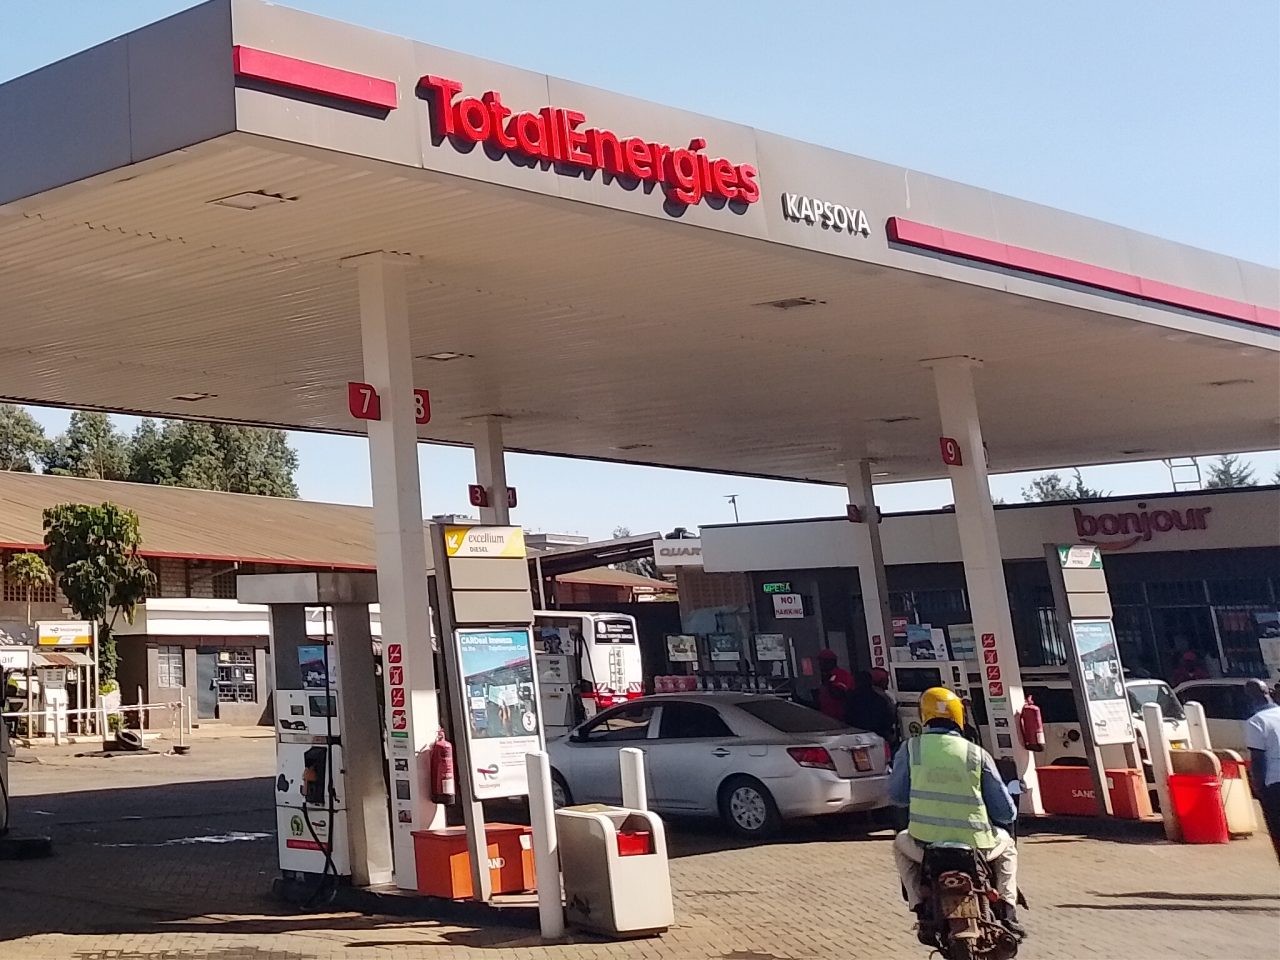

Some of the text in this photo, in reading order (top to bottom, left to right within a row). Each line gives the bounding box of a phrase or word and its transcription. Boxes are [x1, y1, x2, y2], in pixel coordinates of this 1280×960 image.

[420, 74, 760, 205] TotalEnergies
[783, 192, 871, 235] KAPSOYA
[359, 388, 371, 414] 7
[414, 393, 425, 419] 8
[946, 441, 956, 461] 9
[472, 487, 482, 504] 3
[1073, 502, 1212, 541] bonjour
[468, 532, 505, 544] excellium
[1, 656, 15, 664] air
[487, 857, 506, 870] AND
